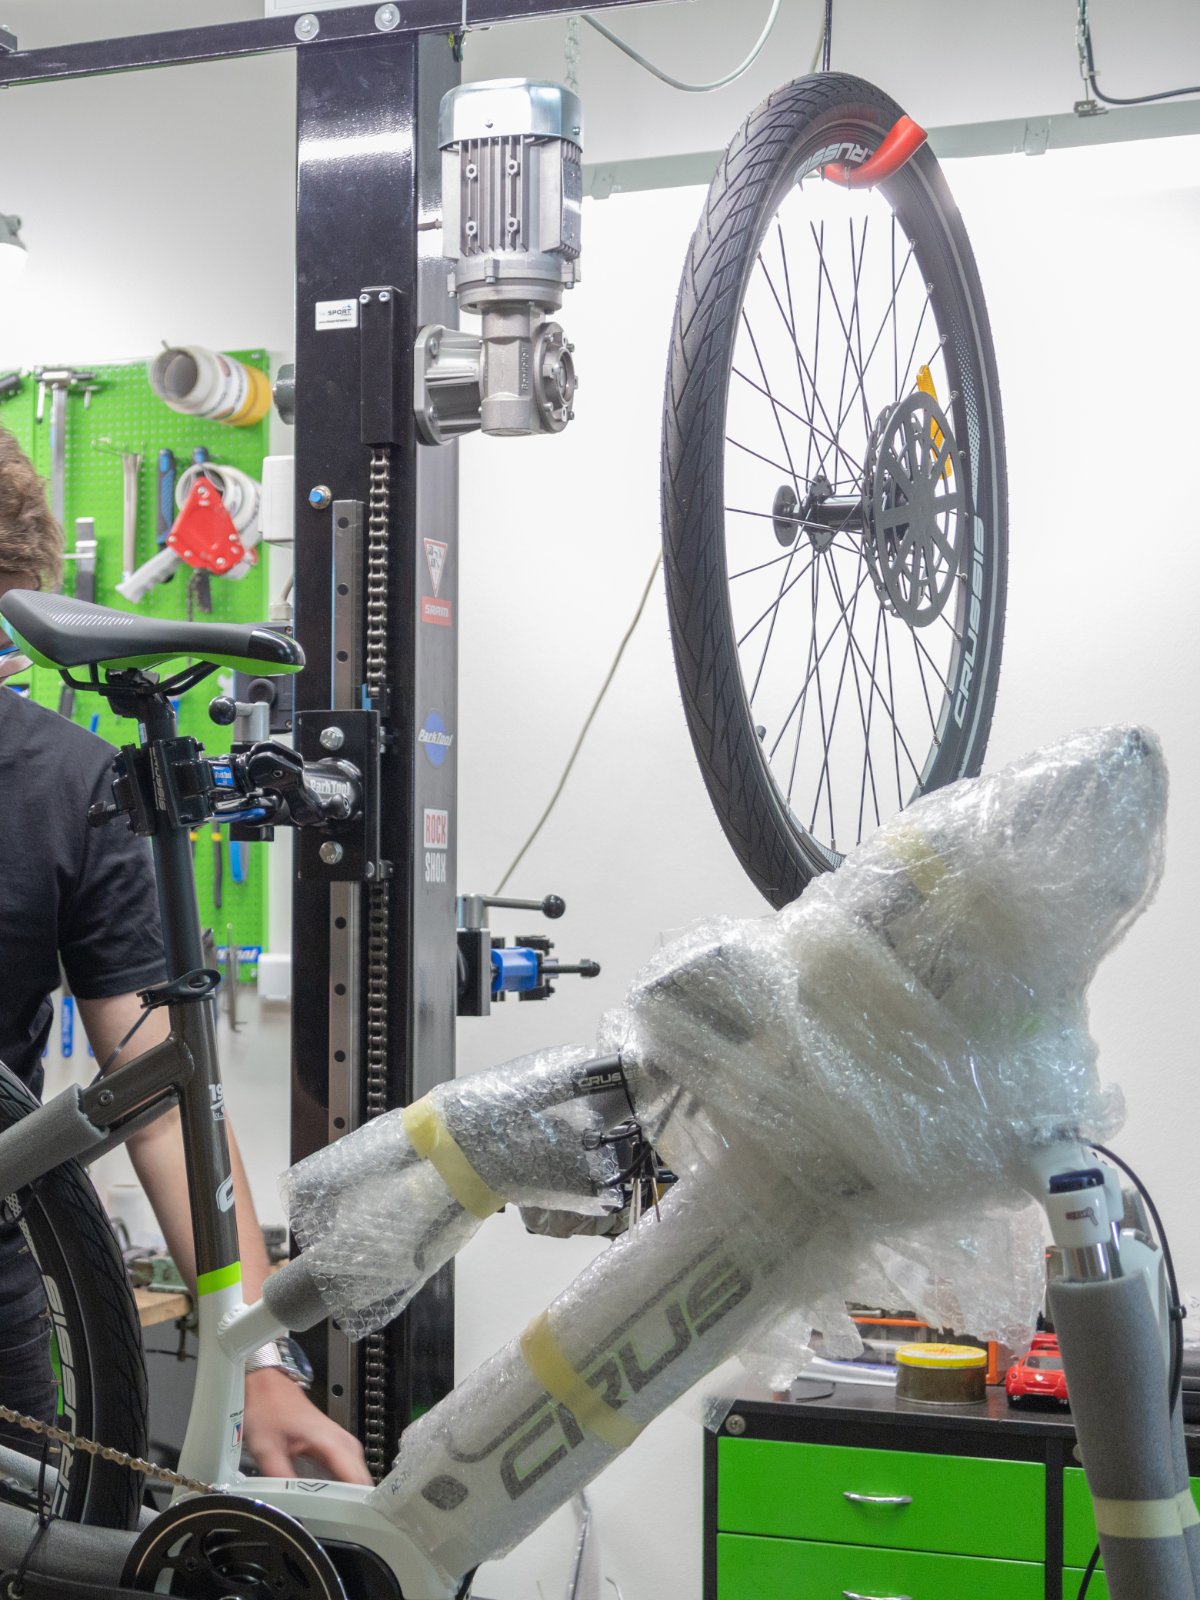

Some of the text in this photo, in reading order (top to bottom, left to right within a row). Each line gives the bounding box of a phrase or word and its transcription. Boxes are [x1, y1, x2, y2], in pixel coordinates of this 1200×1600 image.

[327, 308, 352, 316] SPORT
[424, 603, 449, 618] SRAM
[954, 514, 985, 729] CRUSSIS
[425, 814, 446, 844] ROCK
[424, 852, 446, 883] SHOX
